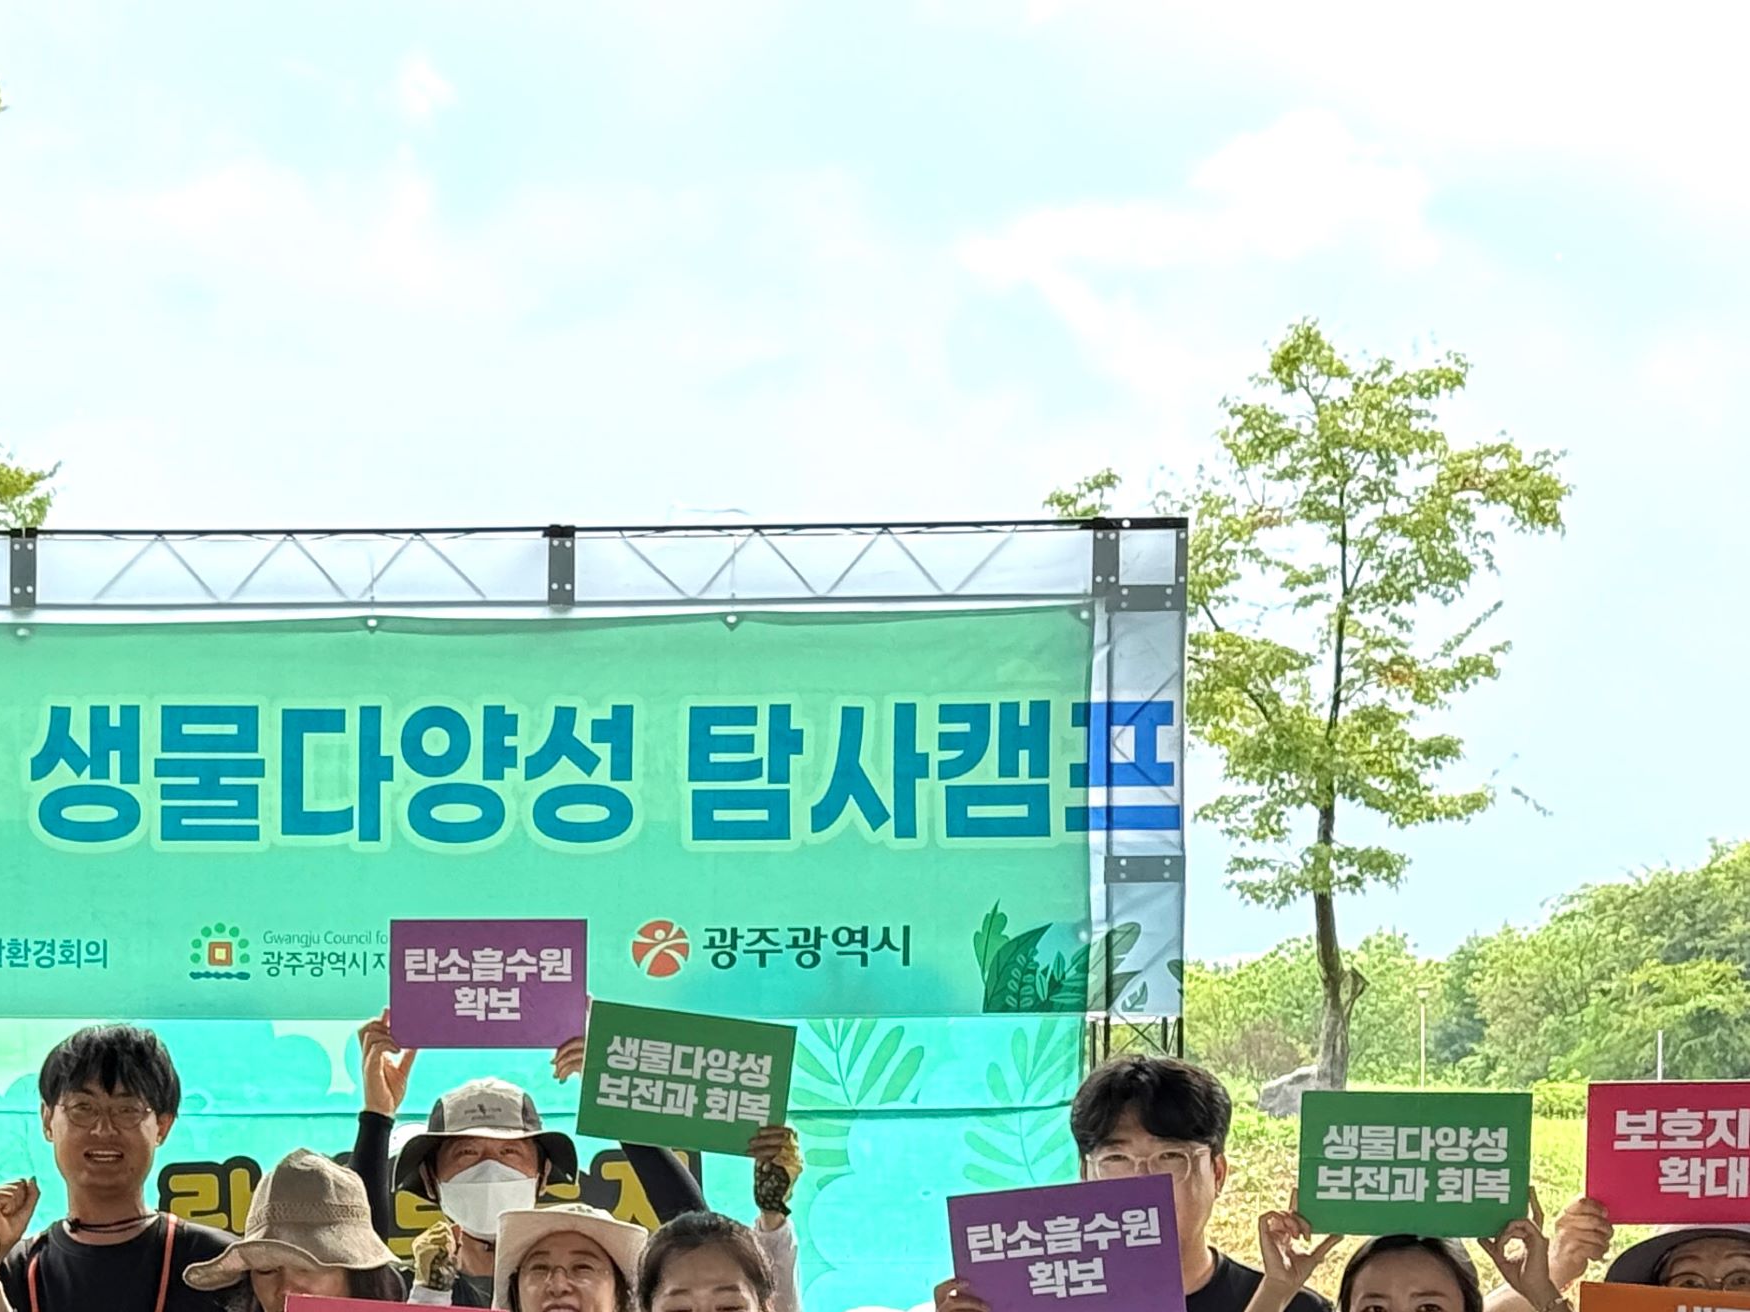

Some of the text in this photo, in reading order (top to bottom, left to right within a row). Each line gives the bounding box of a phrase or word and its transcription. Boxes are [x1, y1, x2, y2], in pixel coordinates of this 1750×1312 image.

[30, 704, 634, 843] 생물다양성
[688, 699, 1180, 841] 탐사캠프
[263, 930, 388, 947] Gwangju Council fo
[702, 924, 912, 970] 광주광역시
[261, 951, 368, 977] 광주광역시
[405, 948, 572, 982] 탄소흡수원
[454, 987, 521, 1021] 확보
[607, 1036, 772, 1088] 생물다양성
[596, 1073, 771, 1127] 보전과 회복
[1323, 1125, 1508, 1162] 생물다양성
[1614, 1108, 1750, 1150] 보호지
[1316, 1166, 1510, 1204] 보전과 회복
[1659, 1157, 1749, 1198] 확대
[966, 1207, 1161, 1263] 탄소흡수원
[1028, 1257, 1107, 1298] 확보
